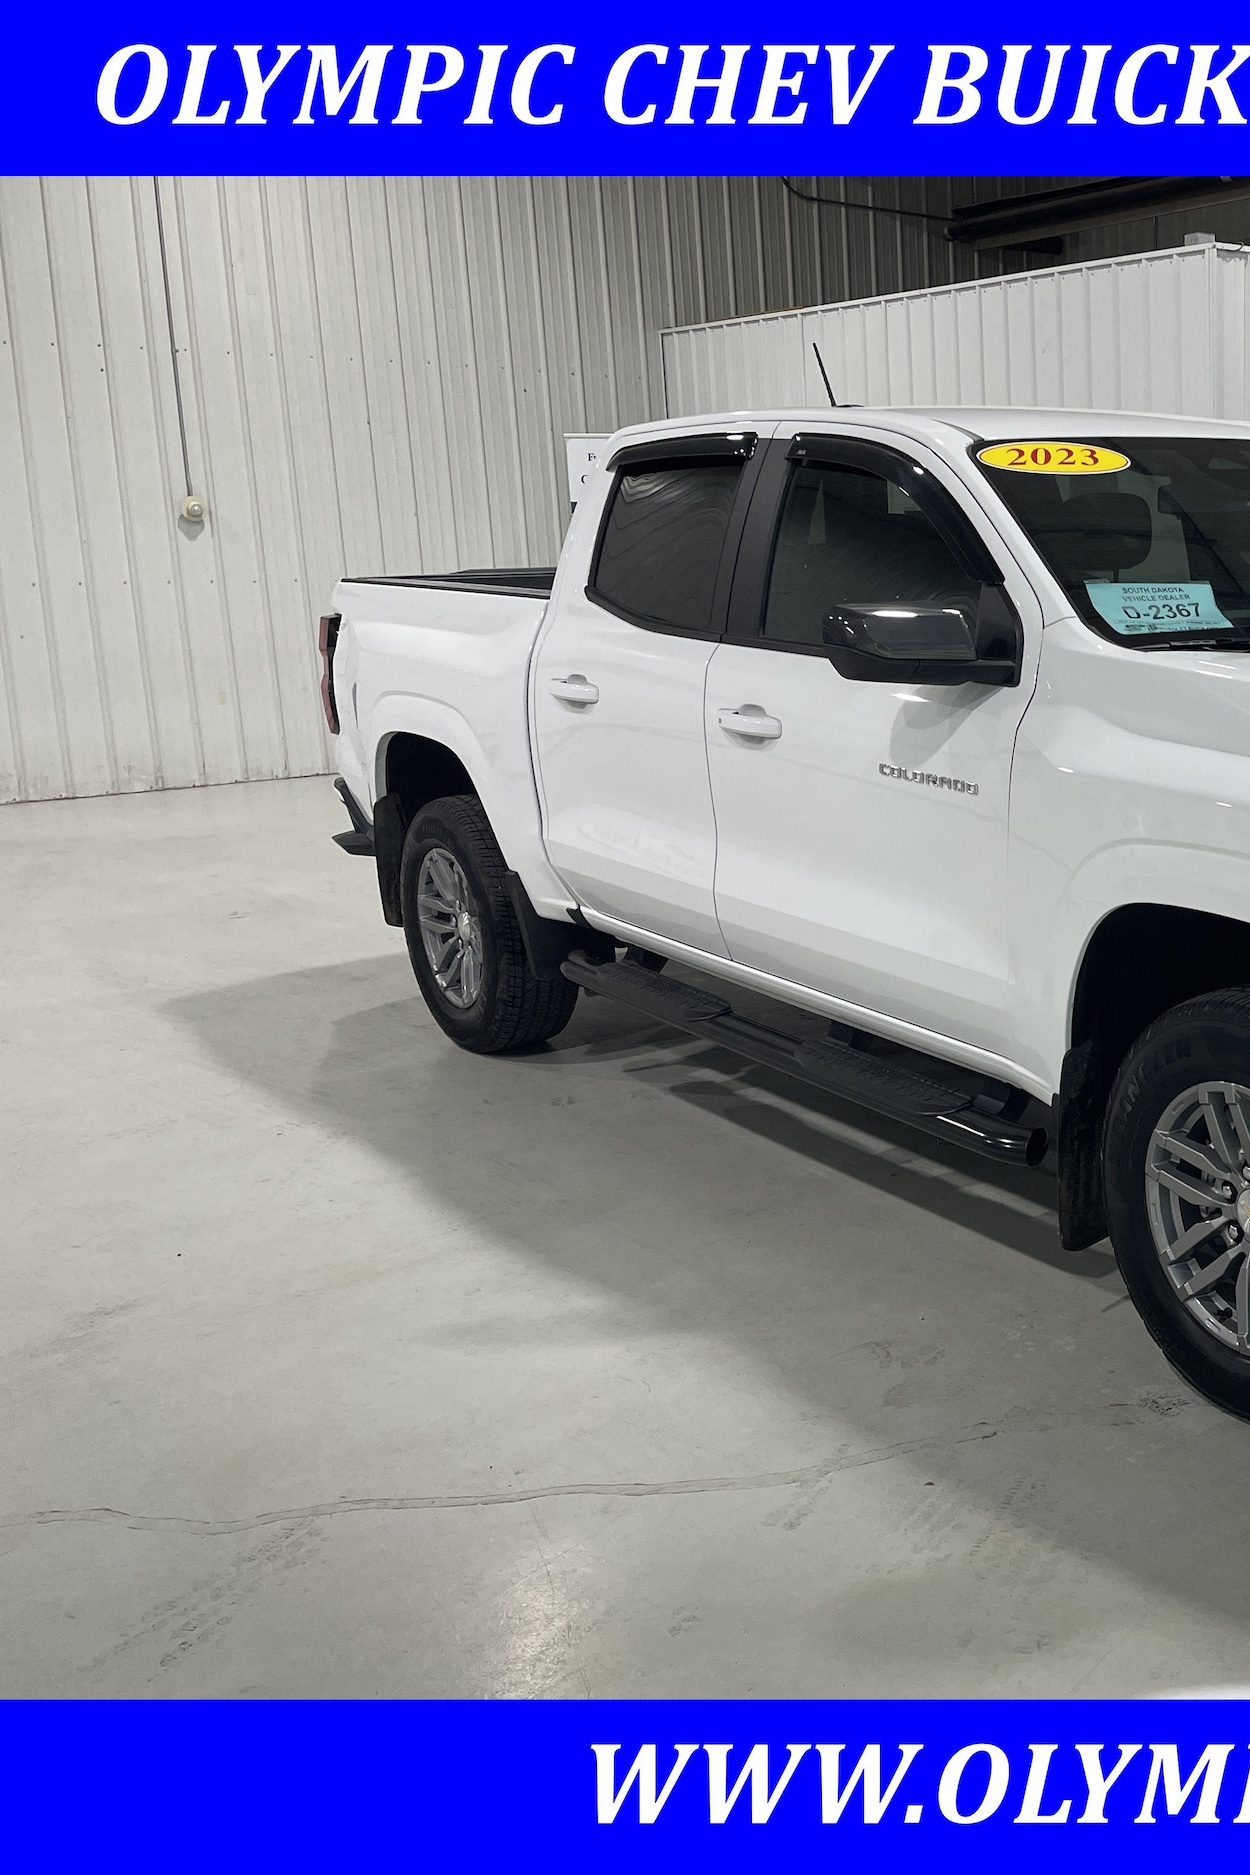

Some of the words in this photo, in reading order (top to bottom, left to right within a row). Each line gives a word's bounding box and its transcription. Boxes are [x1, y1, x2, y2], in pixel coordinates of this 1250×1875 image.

[1006, 447, 1100, 467] 2023
[1122, 602, 1201, 620] D-2367
[878, 763, 979, 796] COLORADO
